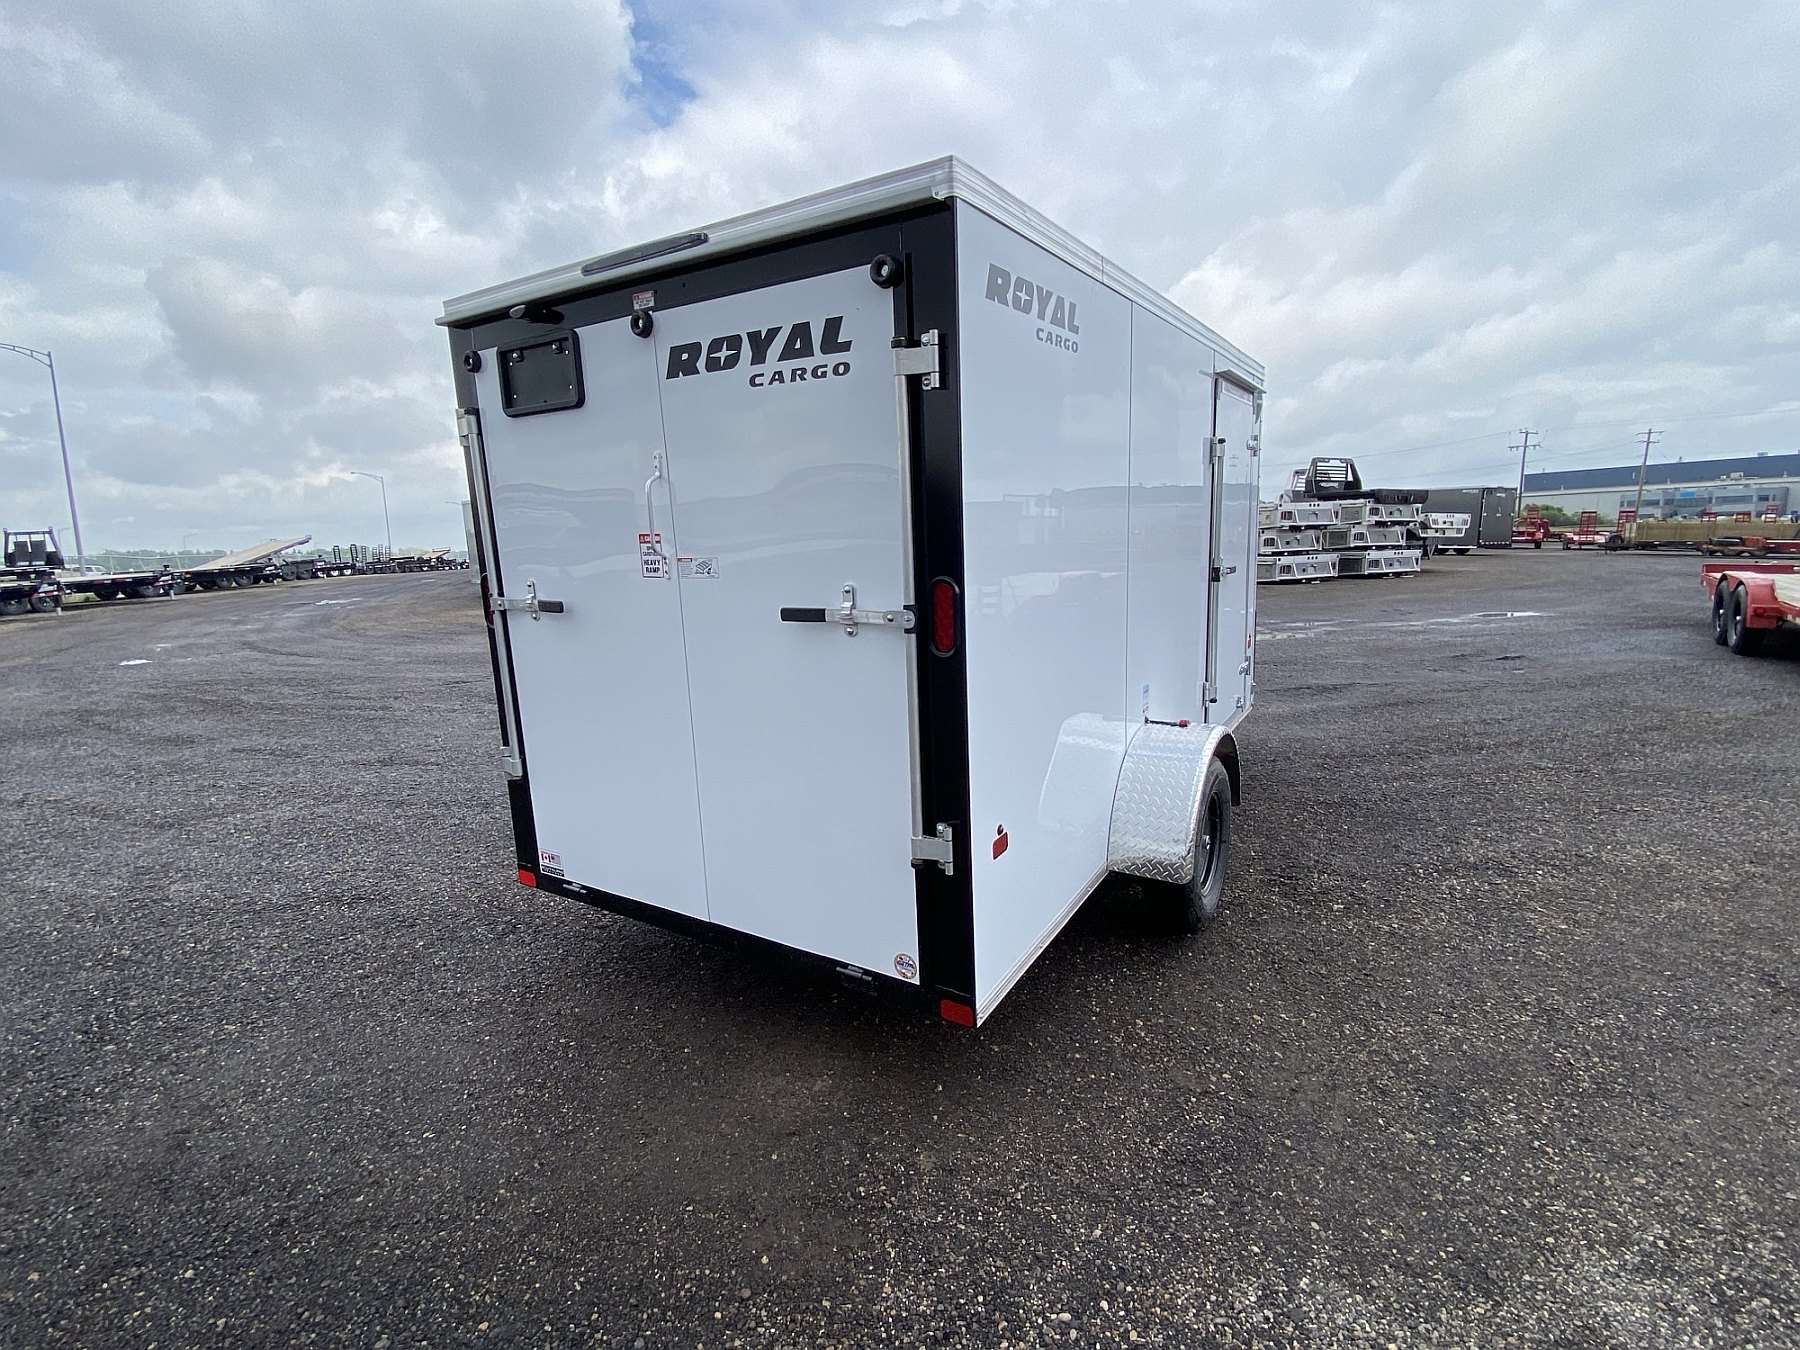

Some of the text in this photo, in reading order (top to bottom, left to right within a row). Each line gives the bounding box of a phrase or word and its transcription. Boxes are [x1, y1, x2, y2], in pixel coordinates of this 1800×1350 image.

[984, 263, 1080, 335] ROYAL
[666, 315, 854, 380] ROYAL
[1036, 327, 1079, 353] CARGO
[749, 361, 851, 388] CARGO
